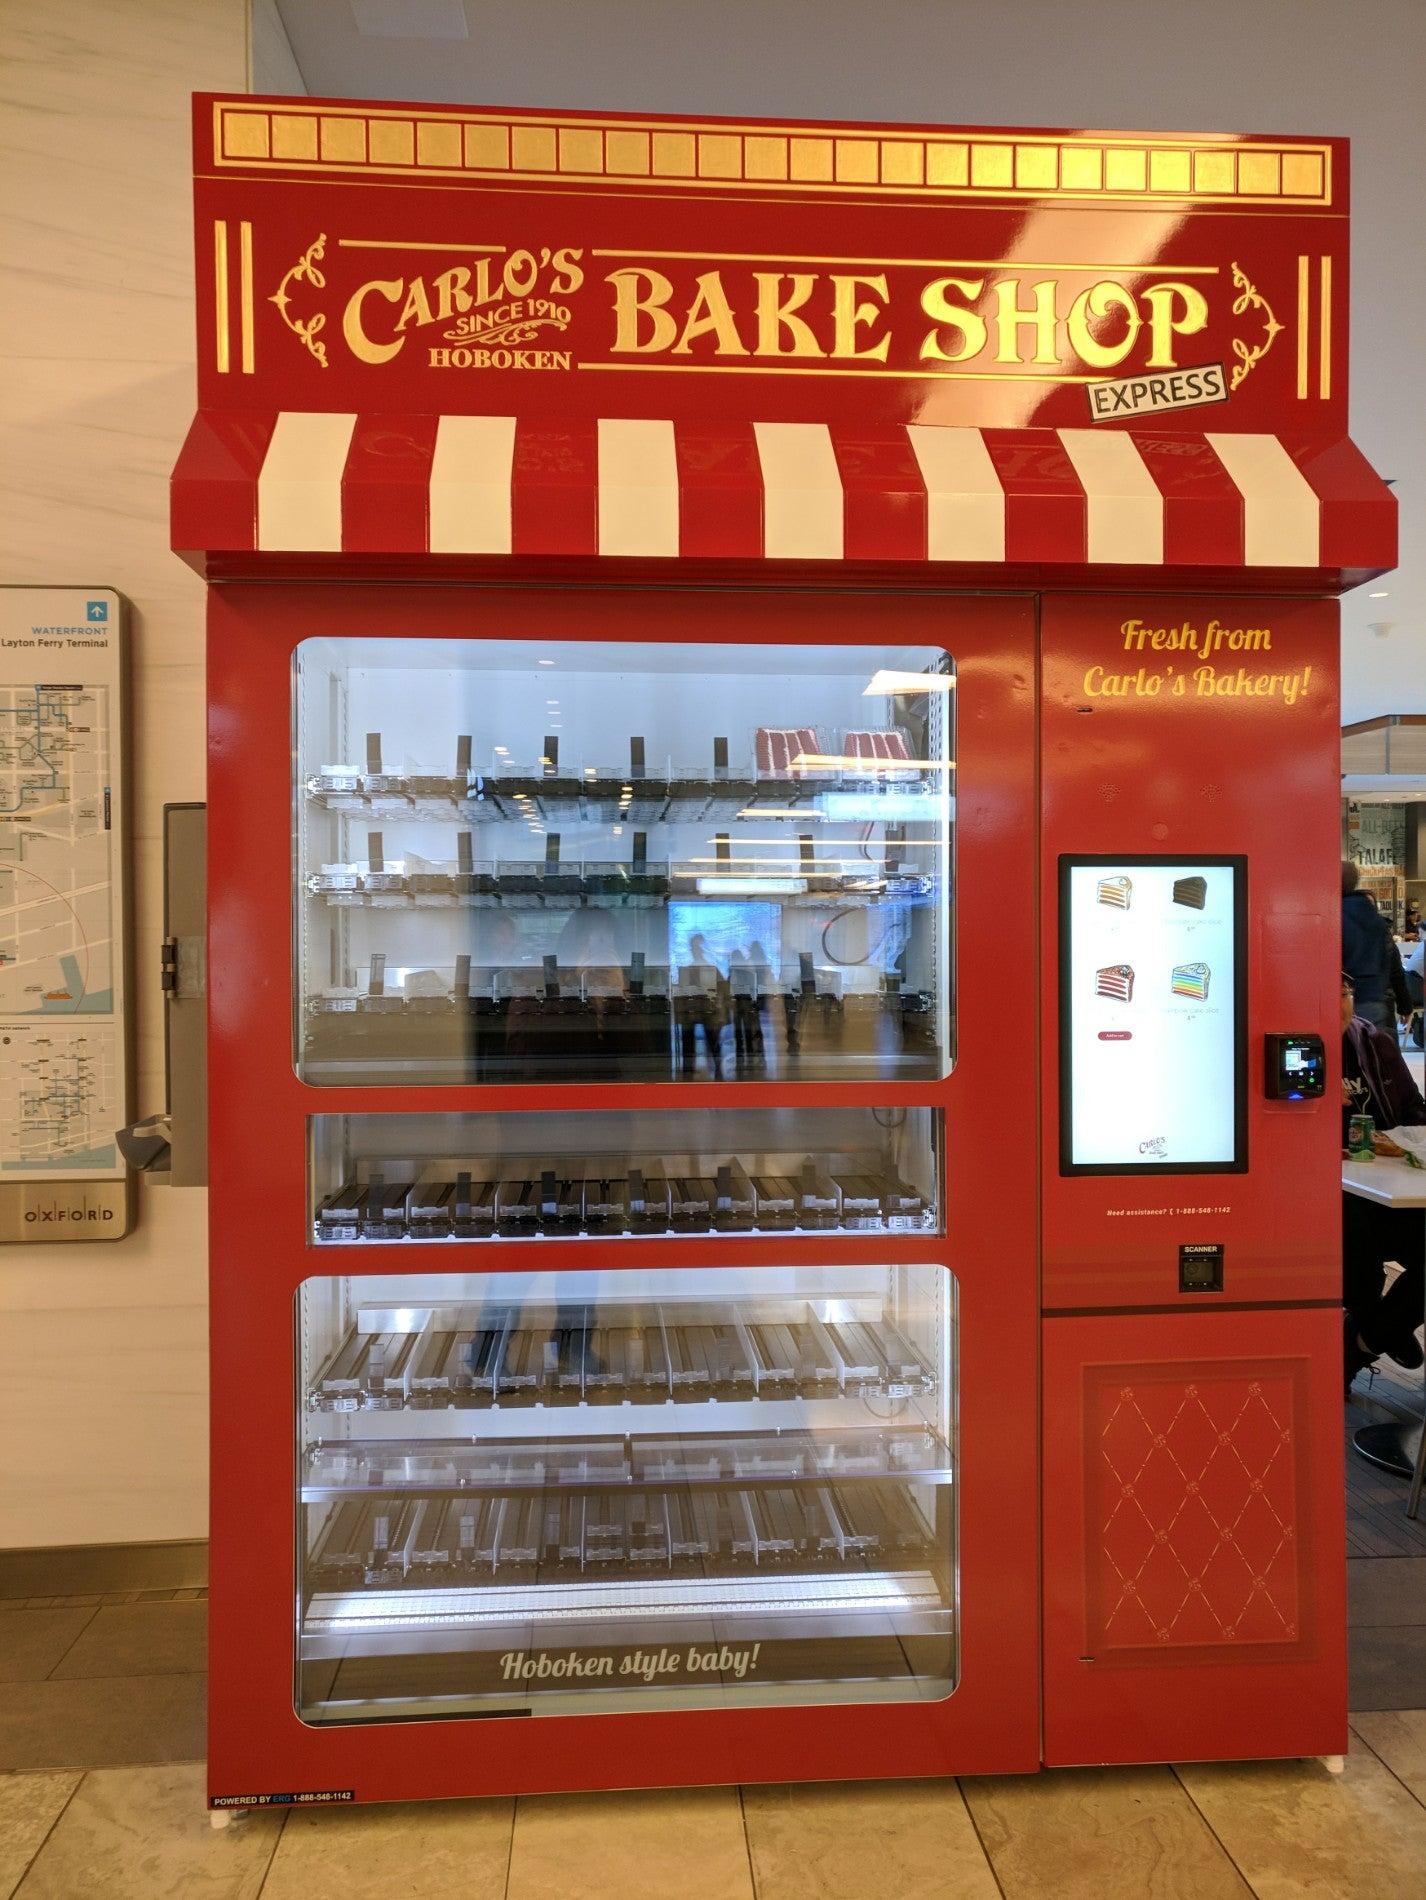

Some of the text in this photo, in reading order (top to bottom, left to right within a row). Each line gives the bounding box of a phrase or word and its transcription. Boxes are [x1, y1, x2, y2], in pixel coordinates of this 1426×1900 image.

[343, 247, 1209, 368] CARLO'S BAKE SHOP
[456, 298, 571, 335] SINCE 1910
[428, 348, 573, 370] HOBOKEN
[1093, 370, 1221, 414] EXPRESS
[1, 639, 108, 648] Layton Ferry Terminal
[31, 627, 108, 635] WATERFRONT
[1120, 619, 1272, 659] Fresh from
[1083, 666, 1312, 705] Carlo's Bakery!
[24, 1209, 114, 1222] OXFORD
[1126, 1208, 1168, 1216] assistance?
[500, 1643, 761, 1682] Hoboken style baby!
[214, 1796, 258, 1806] POWERED
[259, 1795, 272, 1804] BY
